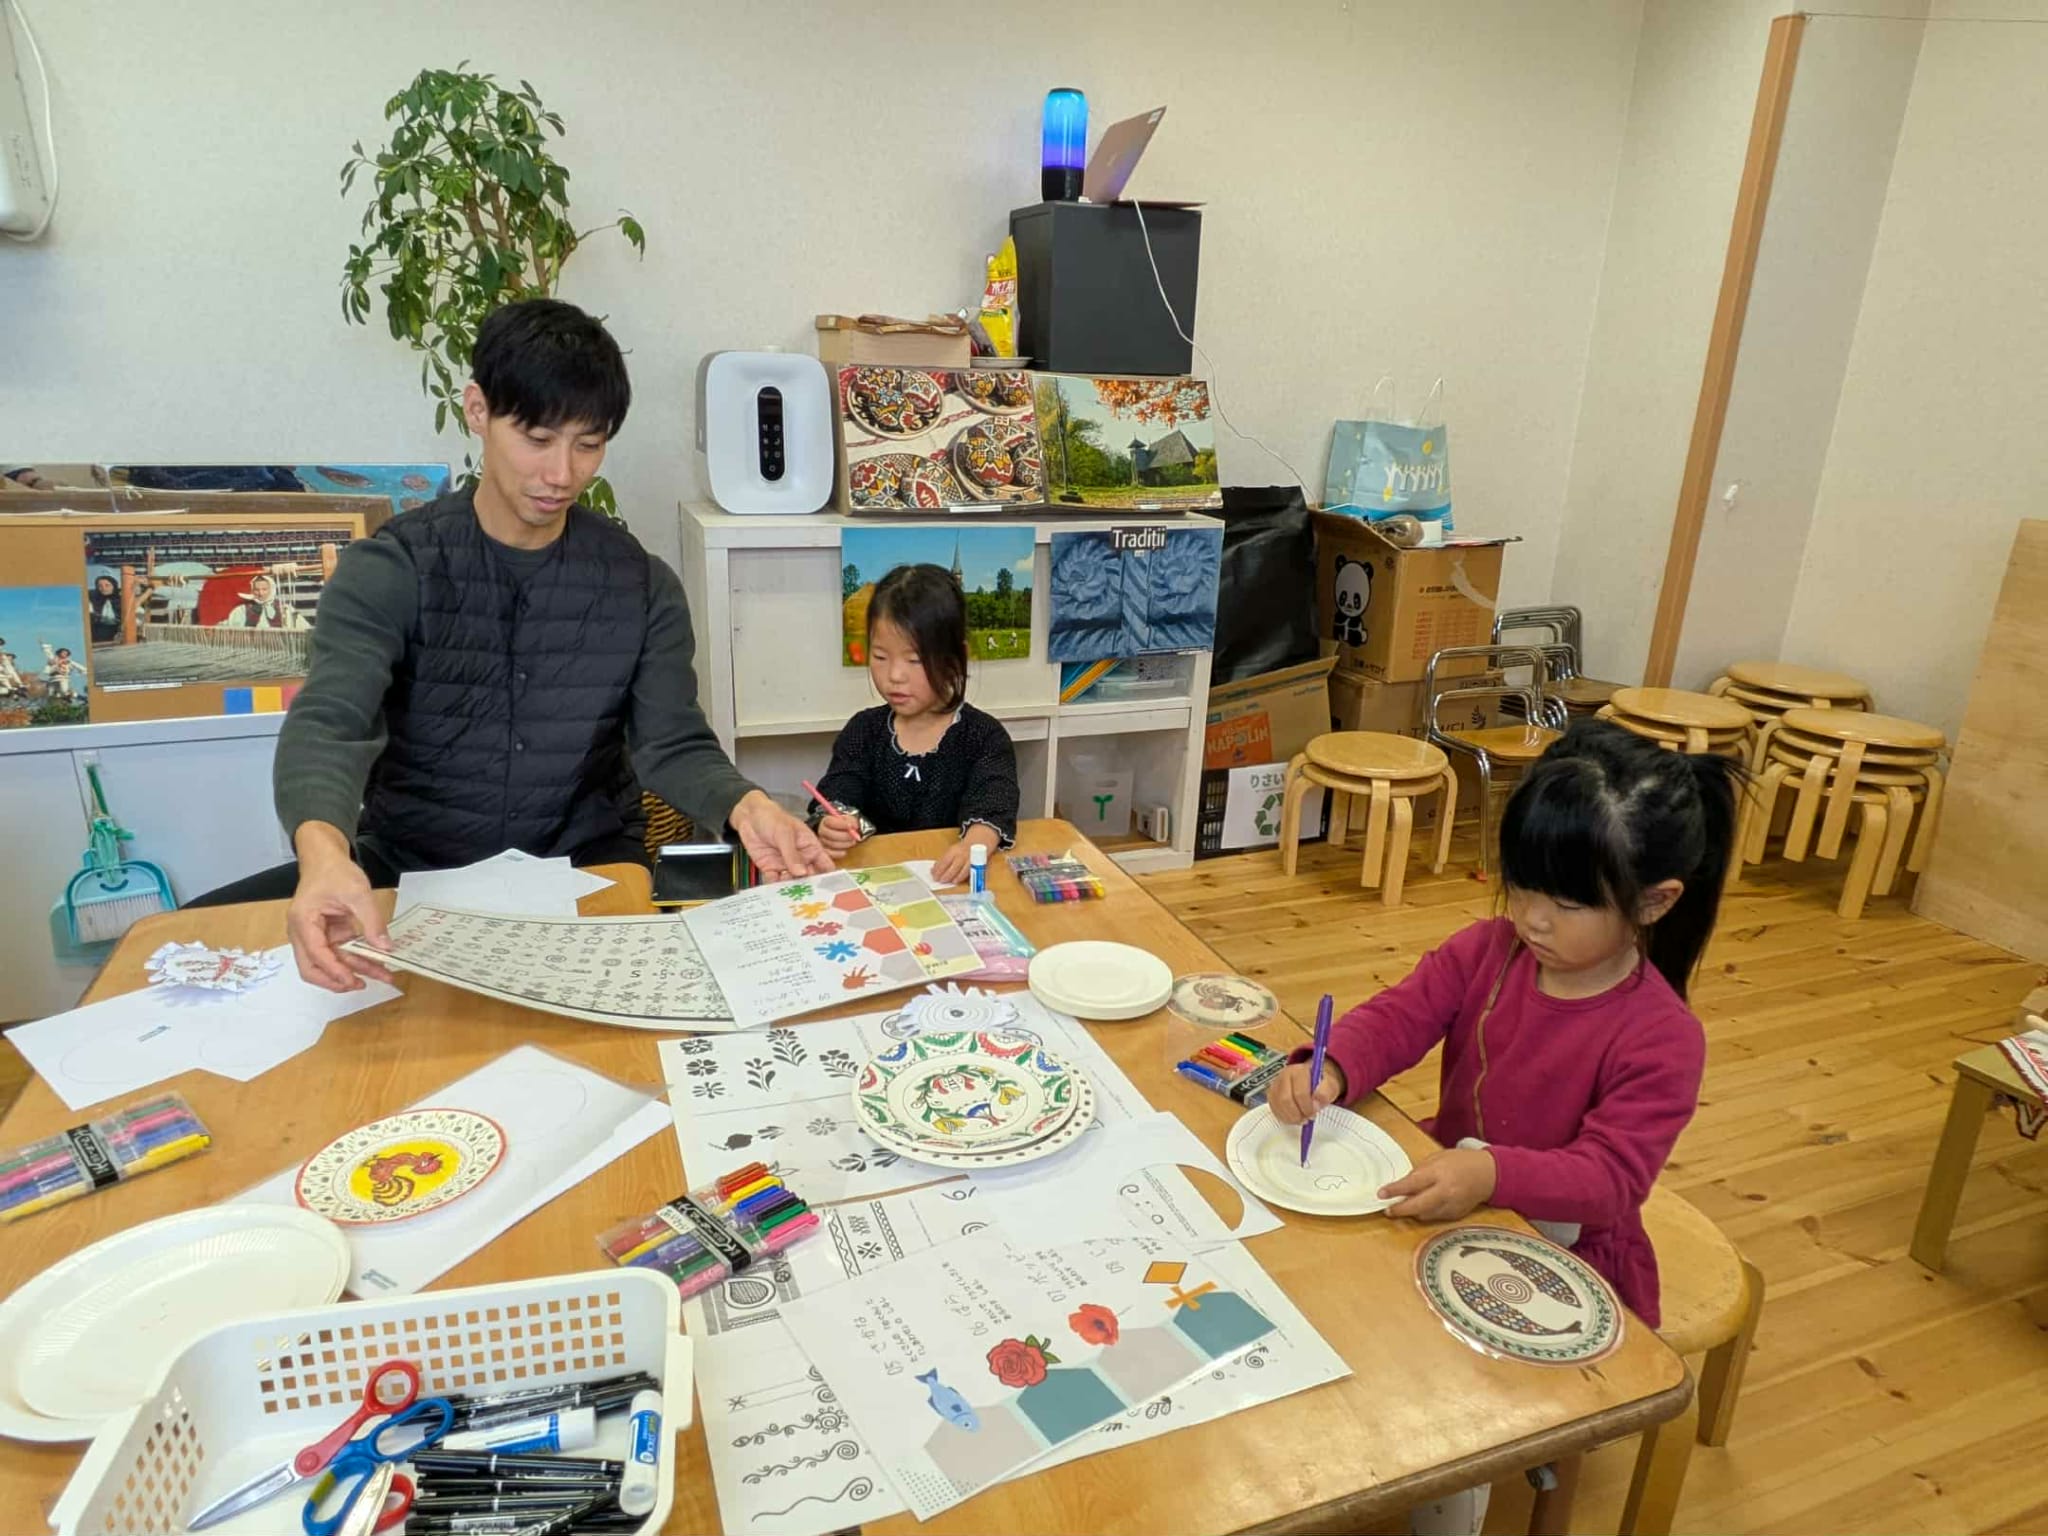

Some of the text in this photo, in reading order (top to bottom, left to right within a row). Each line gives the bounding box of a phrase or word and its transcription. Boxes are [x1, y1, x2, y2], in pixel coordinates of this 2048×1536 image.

[1250, 771, 1287, 788] りさい
[972, 1320, 990, 1336] 06
